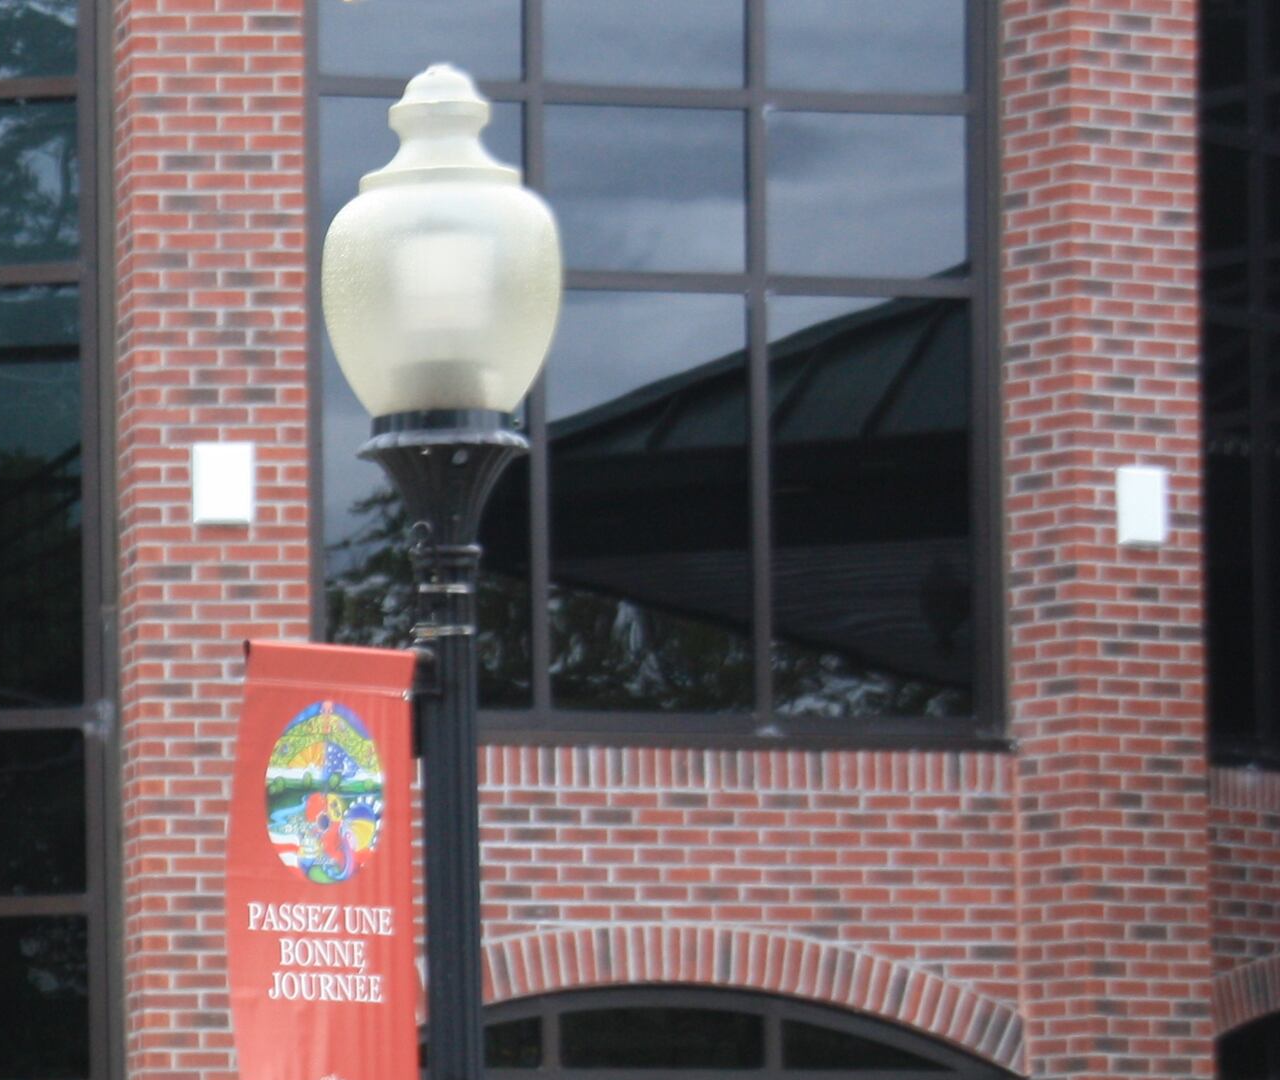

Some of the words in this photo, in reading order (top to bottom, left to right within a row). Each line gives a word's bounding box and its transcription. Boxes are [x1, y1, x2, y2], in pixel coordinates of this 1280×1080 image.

[247, 902, 339, 933] PASSEZ
[343, 906, 393, 936] UNE
[279, 938, 366, 968] BONNE
[268, 967, 383, 1003] JOURNÉE
